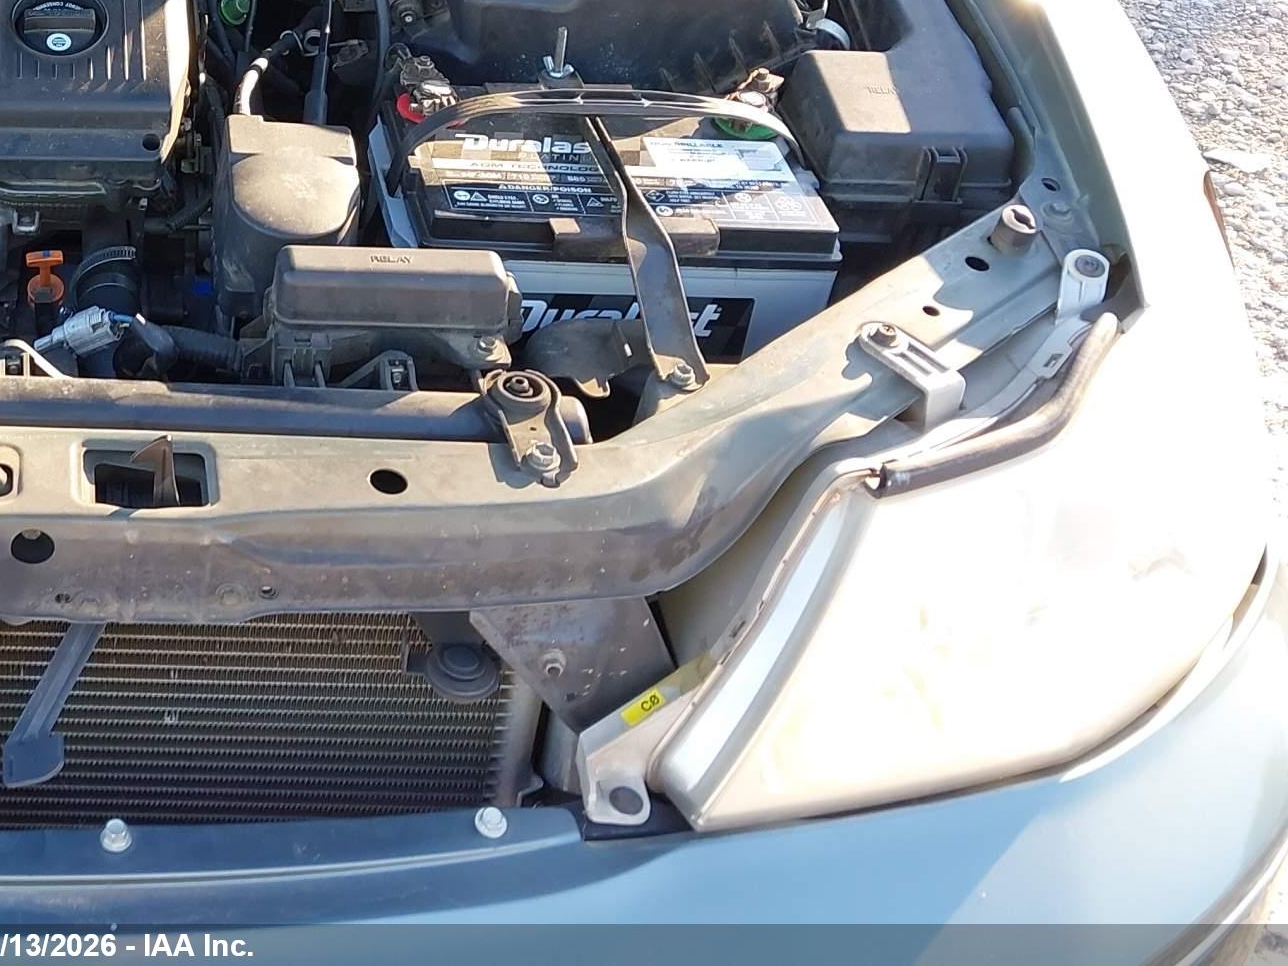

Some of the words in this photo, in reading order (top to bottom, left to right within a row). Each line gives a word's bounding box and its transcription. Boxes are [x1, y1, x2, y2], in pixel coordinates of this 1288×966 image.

[455, 133, 592, 154] Duralas
[511, 162, 601, 172] TECHNOLOG
[370, 255, 412, 264] RELAY
